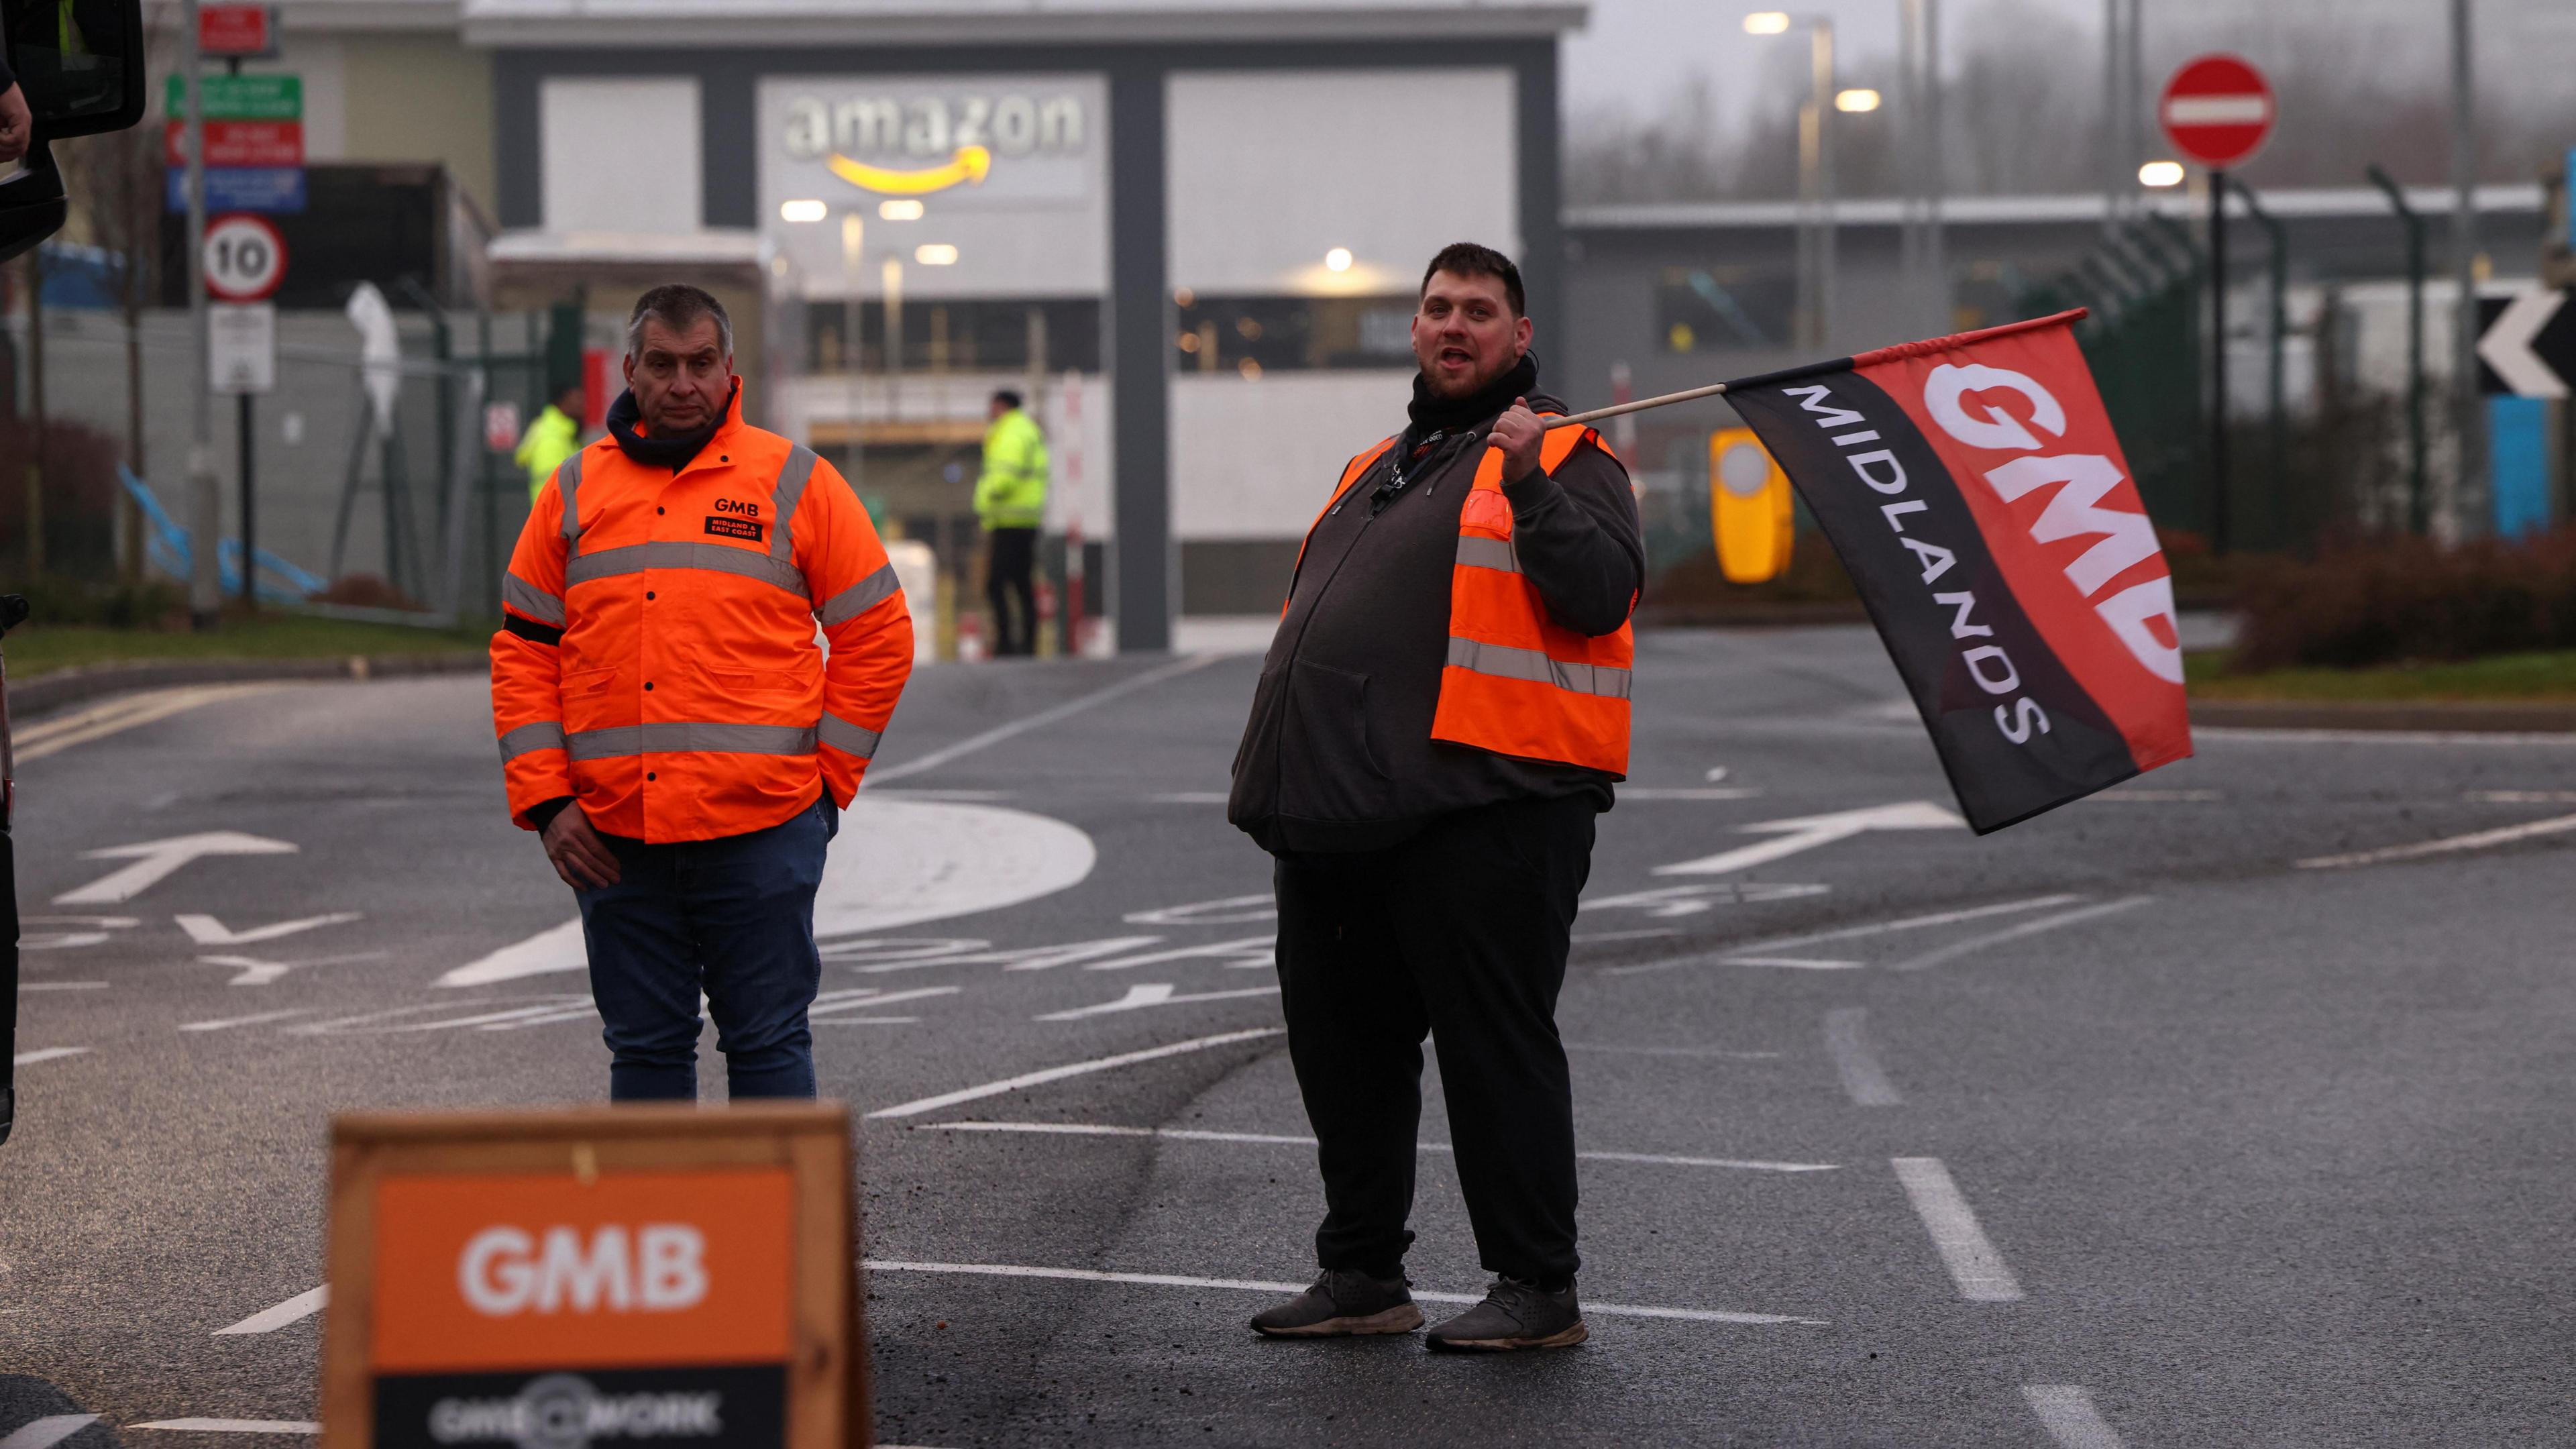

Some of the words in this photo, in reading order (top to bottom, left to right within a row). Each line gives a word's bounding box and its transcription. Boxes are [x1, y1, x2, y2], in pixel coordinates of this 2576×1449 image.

[784, 95, 1085, 156] amazon
[218, 238, 267, 278] 10
[712, 519, 748, 529] MIDLAND
[714, 498, 759, 517] GMB
[711, 525, 730, 533] EAST
[731, 529, 757, 537] COAST
[1781, 384, 2051, 745] MIDLANDS
[458, 1224, 710, 1318] GMB
